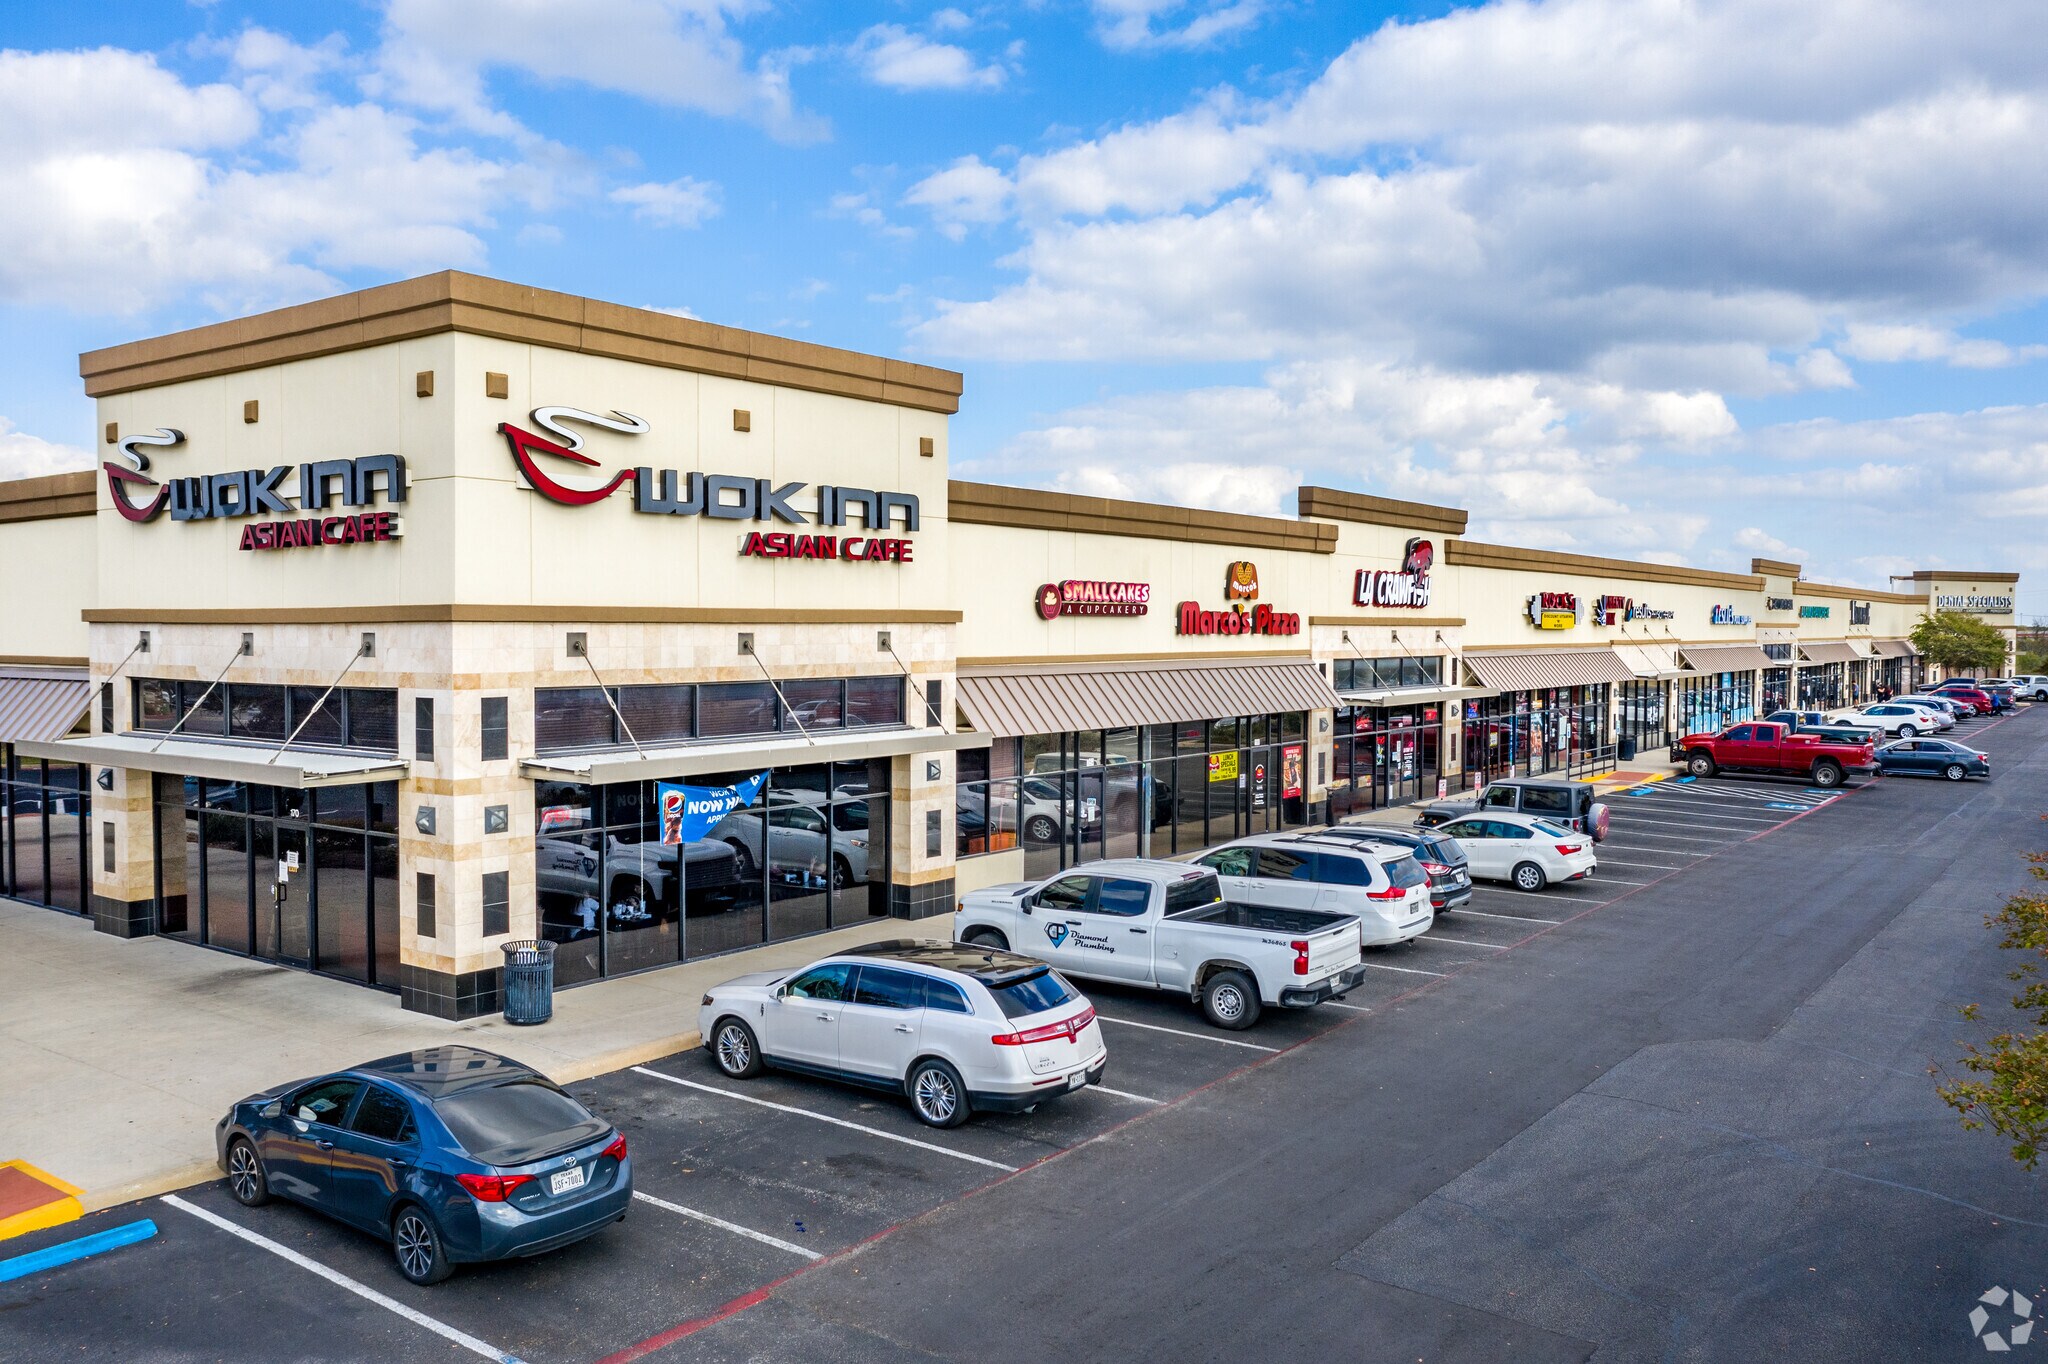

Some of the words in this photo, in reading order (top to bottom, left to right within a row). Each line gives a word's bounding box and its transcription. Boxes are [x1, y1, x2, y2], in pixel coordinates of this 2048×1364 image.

[169, 465, 297, 521] WOK
[634, 467, 809, 524] WOK
[239, 518, 321, 551] ASIAN
[321, 512, 400, 545] CAFE
[742, 531, 837, 560] ASIAN
[841, 537, 914, 563] CAFE
[1062, 580, 1150, 603] SMALLCAKES
[1357, 570, 1374, 605] LA
[1067, 604, 1073, 614] A
[1079, 604, 1145, 615] CUPCAKERY
[1938, 595, 1965, 608] DENTAL
[1968, 595, 2013, 608] SPECIALISTS
[1178, 601, 1250, 635] Marco's
[1253, 603, 1300, 635] Pizza
[688, 799, 724, 815] NOW
[725, 796, 743, 810] HI
[1070, 929, 1109, 943] Diamond
[1074, 938, 1116, 954] Plumbing
